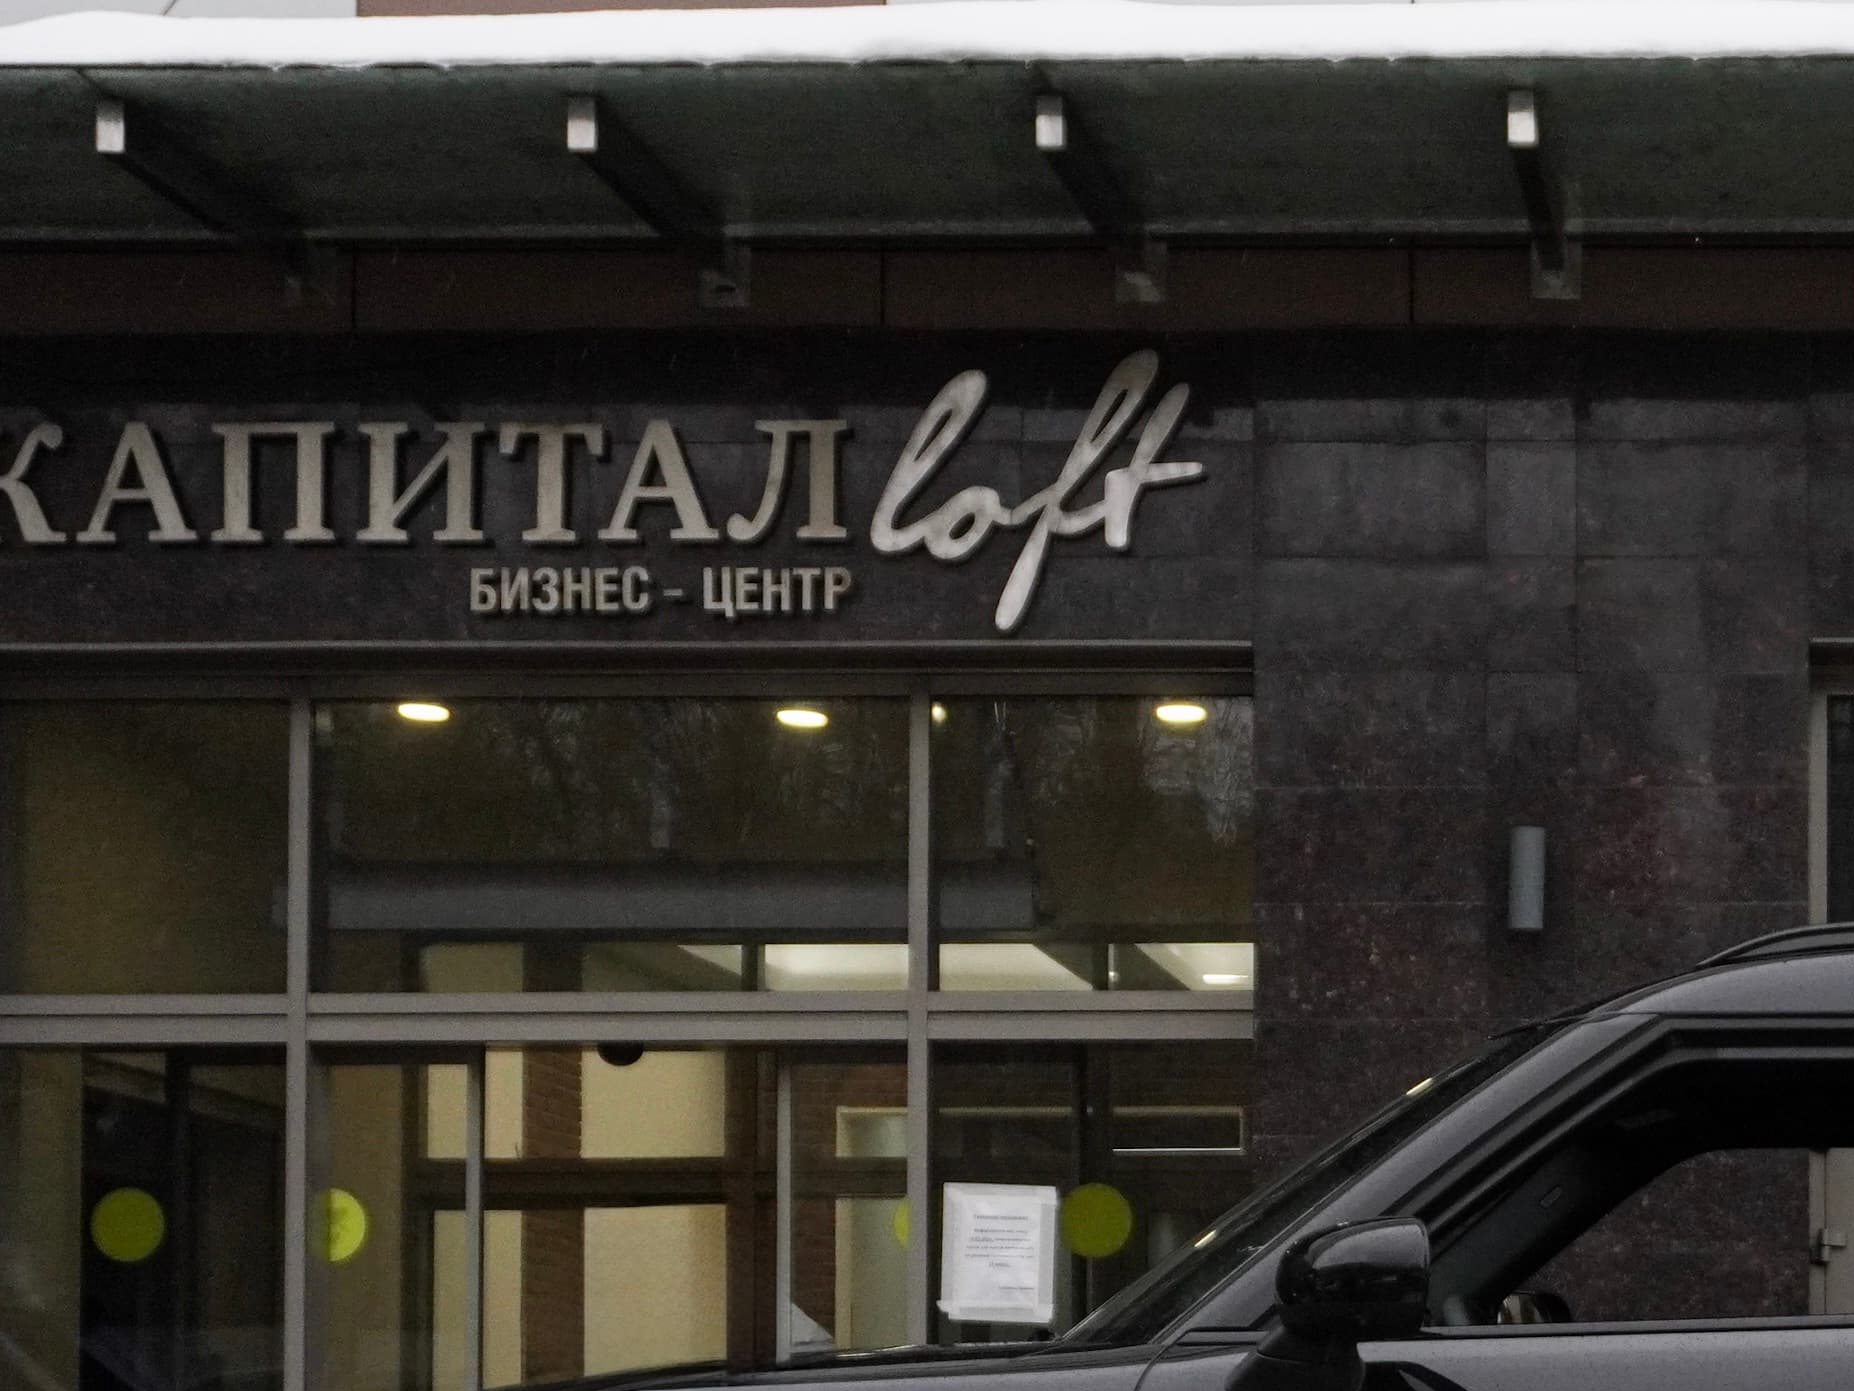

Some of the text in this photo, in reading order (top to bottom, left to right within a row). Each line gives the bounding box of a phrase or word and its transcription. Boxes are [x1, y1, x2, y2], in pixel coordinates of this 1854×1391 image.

[870, 348, 1204, 632] loft
[469, 565, 650, 613] БИЗНЕС
[702, 566, 852, 619] ЦЕНТР
